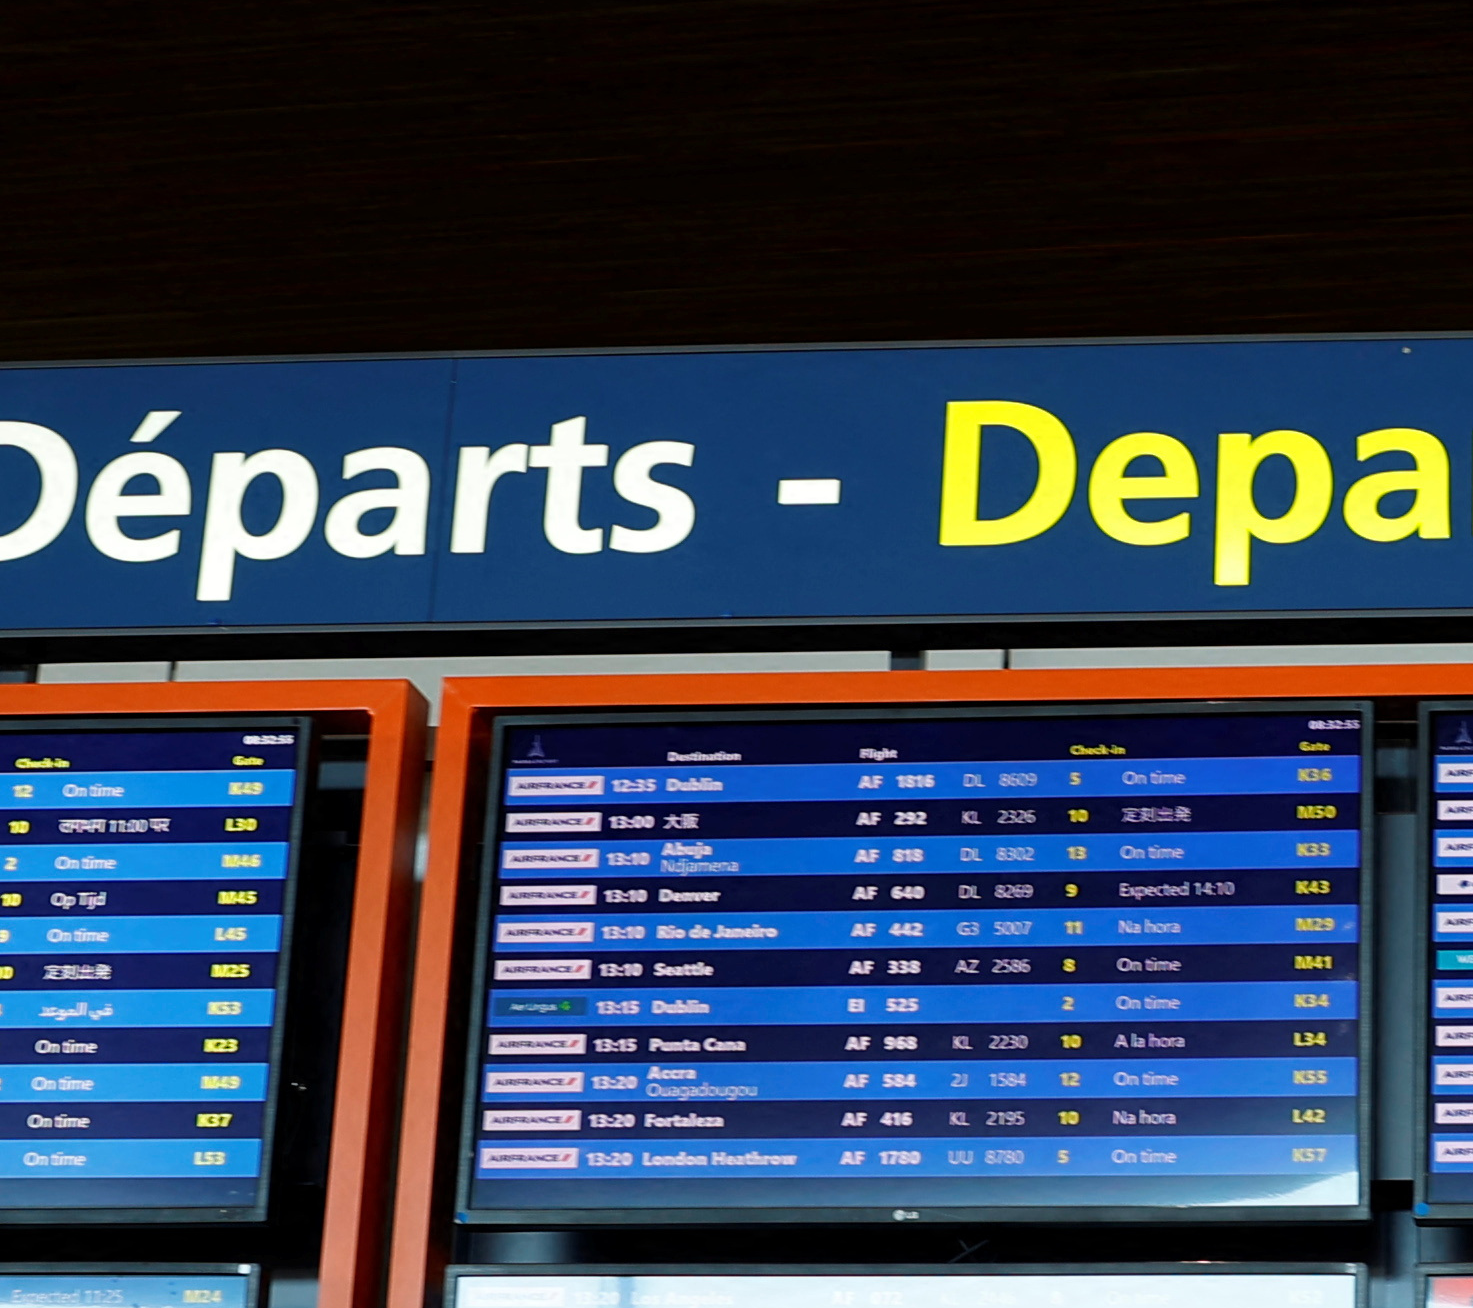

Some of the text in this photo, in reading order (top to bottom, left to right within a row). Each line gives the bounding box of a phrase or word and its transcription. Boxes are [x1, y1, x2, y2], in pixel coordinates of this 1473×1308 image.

[666, 750, 742, 763] Destination
[610, 773, 937, 793] 12:35 Dublin AF 1816
[657, 887, 722, 903] Denver
[652, 961, 715, 978] Seattle
